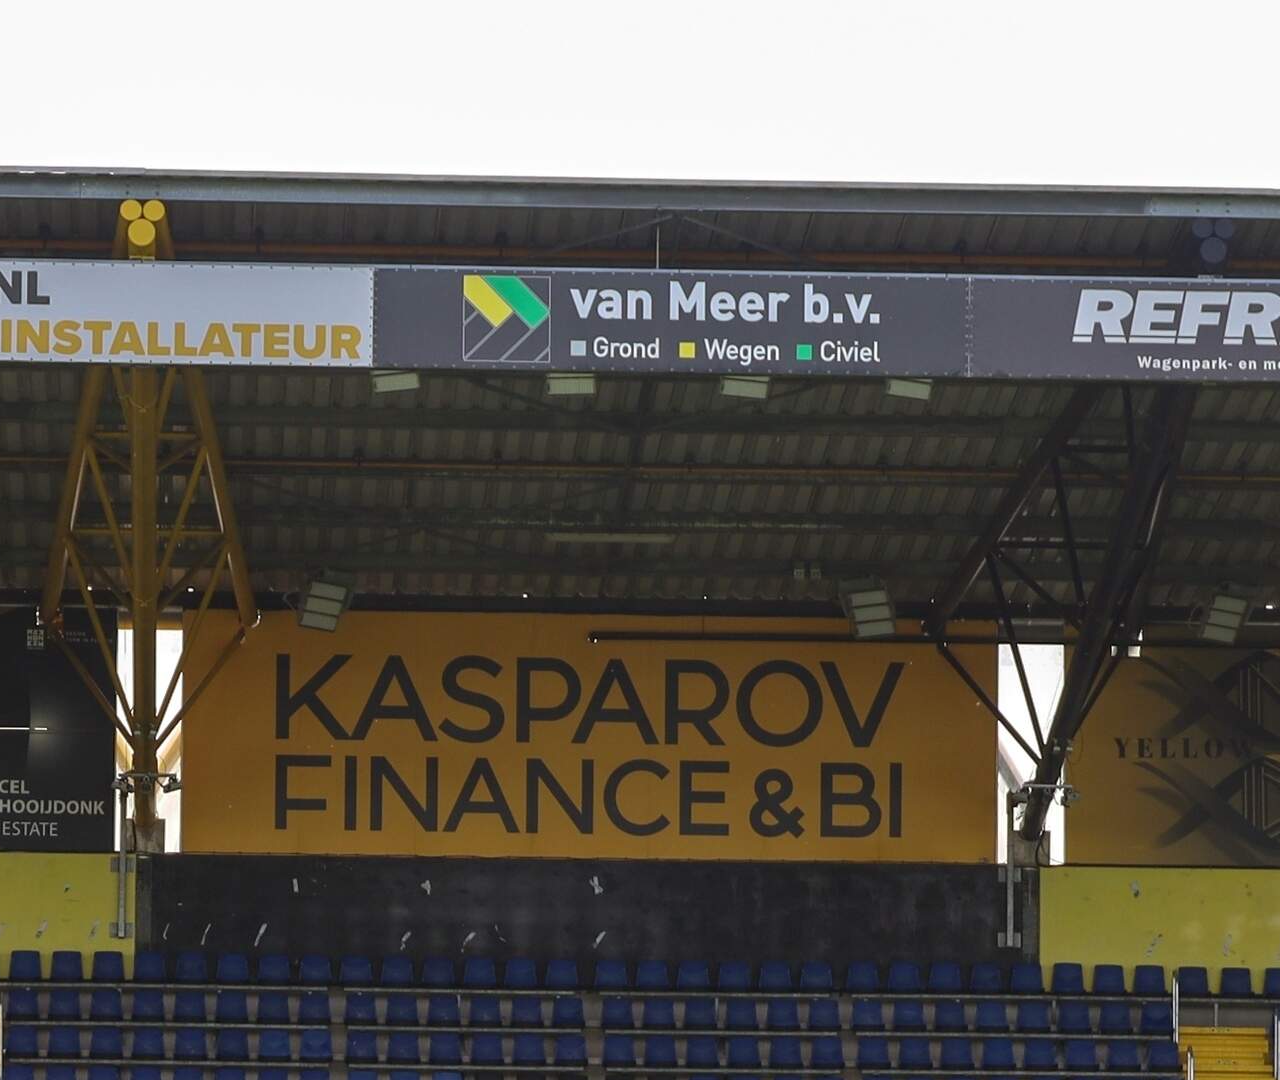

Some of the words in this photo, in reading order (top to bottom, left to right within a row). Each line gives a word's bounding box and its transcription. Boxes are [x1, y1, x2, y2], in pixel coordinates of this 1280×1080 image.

[570, 288, 653, 320] van
[670, 280, 791, 322] Meer
[803, 283, 881, 324] b.v.
[0, 318, 362, 360] INSTALLATEUR
[593, 336, 660, 359] Grond
[820, 340, 881, 363] Civiel
[704, 338, 780, 366] Wegen
[1137, 355, 1233, 372] Wagenpark-
[1238, 357, 1257, 371] en
[274, 652, 906, 749] KASPAROV
[1113, 737, 1253, 760] YELLOW
[274, 754, 731, 838] FINANCE
[2, 821, 59, 837] ESTATE
